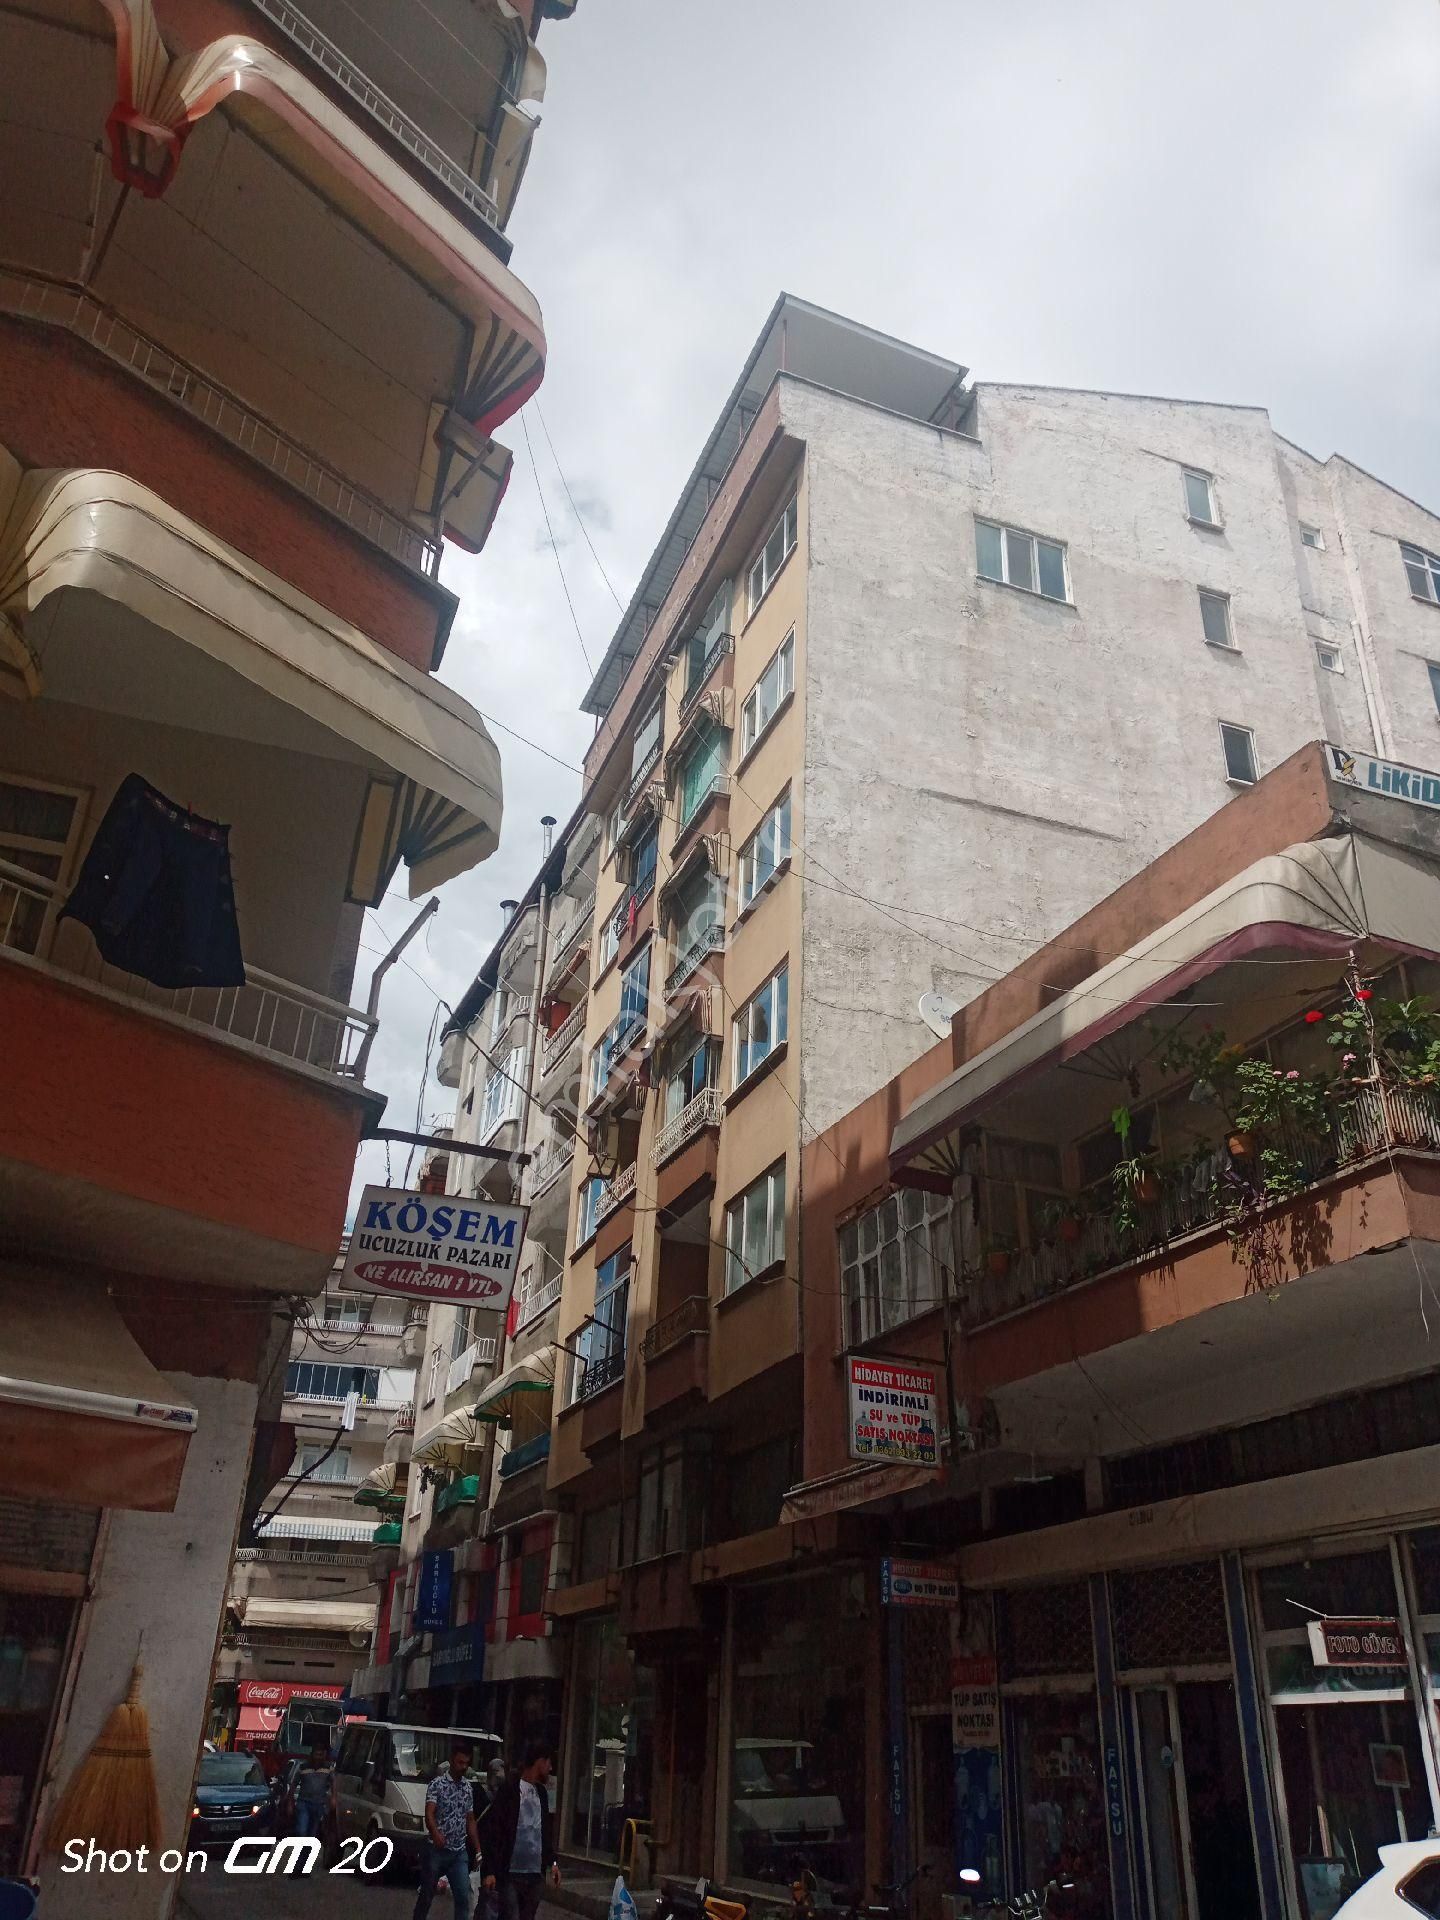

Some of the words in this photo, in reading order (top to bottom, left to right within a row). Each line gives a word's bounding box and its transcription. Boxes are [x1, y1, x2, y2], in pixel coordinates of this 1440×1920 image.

[363, 1197, 517, 1248] KÖŞEM
[359, 1234, 442, 1260] UCUZLUK
[447, 1246, 513, 1270] PAZARI
[363, 1264, 386, 1280] NE
[387, 1268, 453, 1290] ALIRSAN
[455, 1277, 464, 1291] 1
[854, 1364, 893, 1385] HİDAYET
[896, 1372, 932, 1391] TİCARET
[859, 1386, 928, 1410] İNDİRİMLİ
[870, 1408, 882, 1421] SU
[887, 1413, 898, 1423] ve
[901, 1411, 920, 1426] TÜP
[857, 1424, 886, 1440] SATIŞ
[1327, 1635, 1359, 1654] FOTO
[1361, 1632, 1401, 1655] GÜVEN
